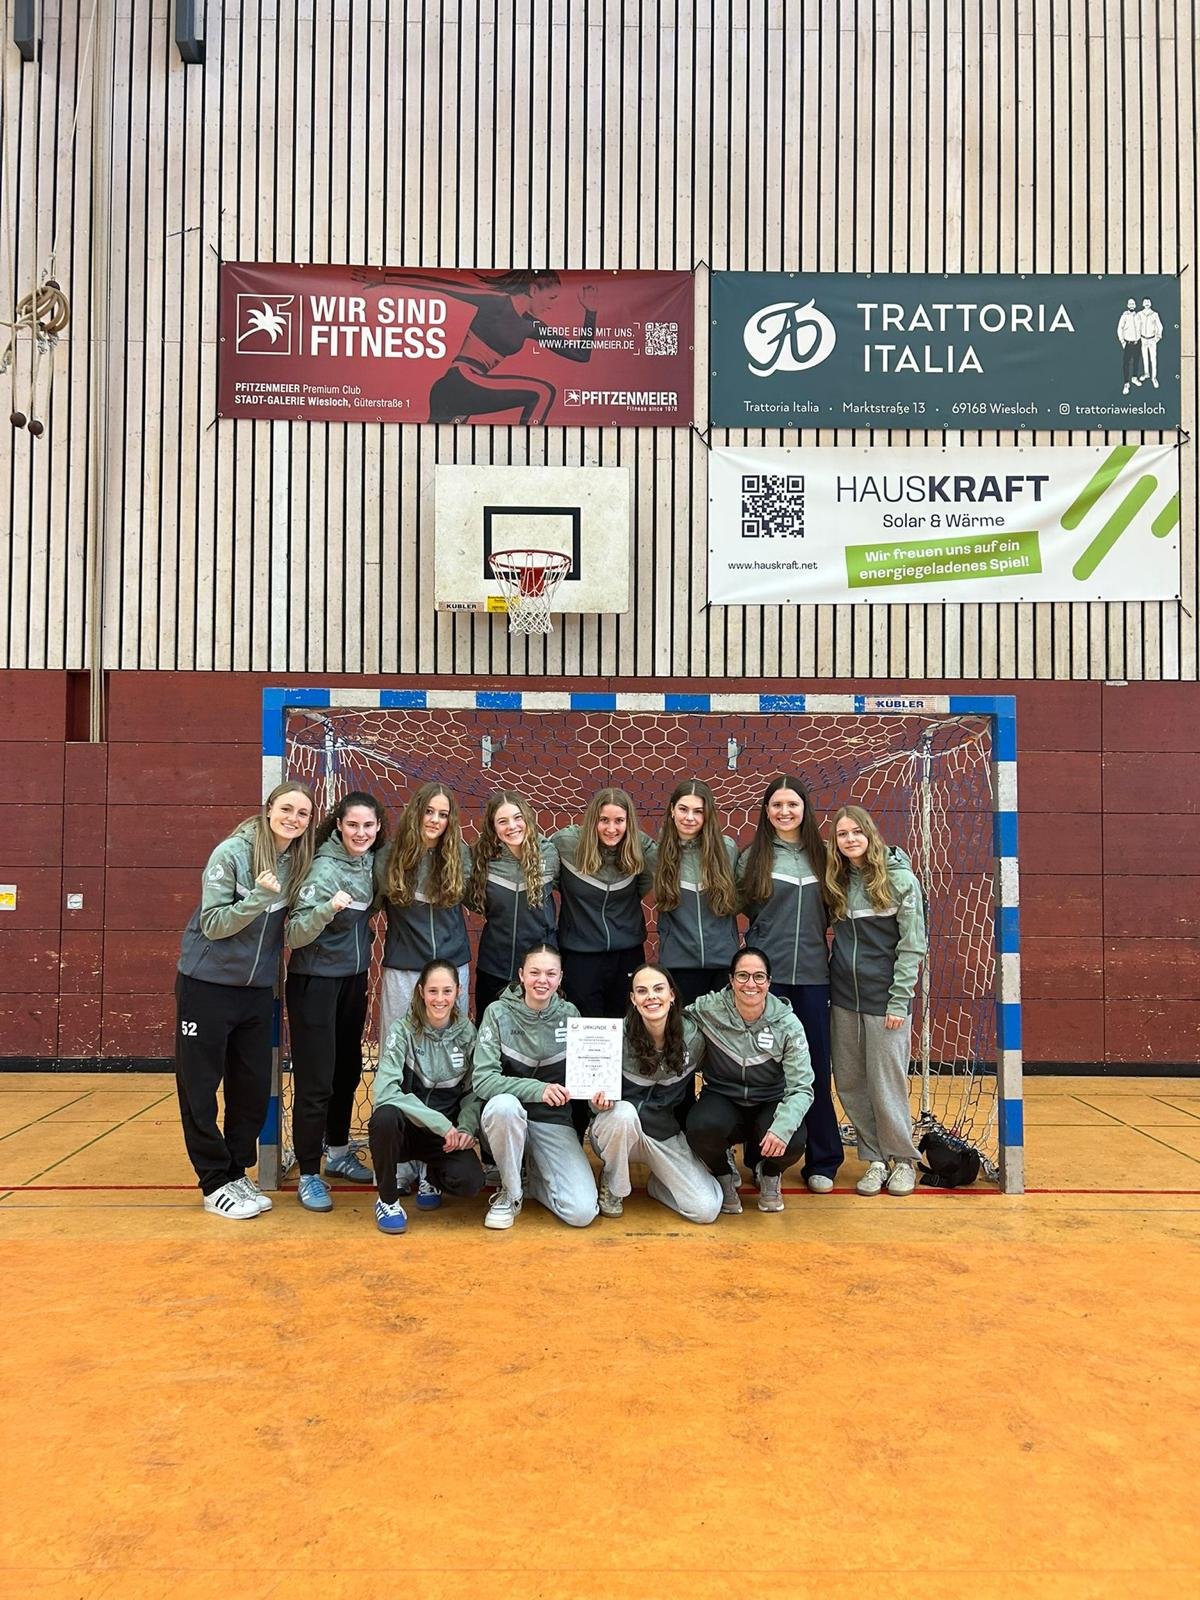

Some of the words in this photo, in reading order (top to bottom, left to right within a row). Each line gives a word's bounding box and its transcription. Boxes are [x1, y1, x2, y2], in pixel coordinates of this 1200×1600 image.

[310, 295, 366, 323] WIR
[377, 297, 447, 325] SIND
[857, 303, 1075, 333] TRATTORIA
[539, 327, 570, 336] WERDE
[573, 327, 593, 337] EINS
[596, 328, 612, 337] MIT
[614, 328, 635, 338] UNS.
[311, 325, 447, 359] FITNESS
[539, 339, 635, 350] WWW.PFITZENMEIER.DE
[864, 345, 984, 374] ITALIA
[235, 382, 300, 393] PFITZENMEIER
[303, 384, 340, 395] Premium
[342, 384, 361, 395] Club
[234, 395, 306, 406] STADT-GALERIE
[308, 396, 351, 408] Wiesloch,
[354, 397, 403, 408] Güterstraße
[406, 398, 411, 408] 1
[582, 391, 678, 406] PFITZENMEIER
[744, 400, 790, 413] Trattoria
[793, 400, 820, 413] Italia
[842, 401, 910, 415] Marktstraße
[913, 402, 926, 414] 13
[951, 402, 987, 415] 69168
[989, 402, 1038, 415] Wiesloch
[1075, 402, 1166, 416] trattoriawiesloch
[836, 475, 1049, 503] HAUSKRAFT
[883, 513, 926, 529] Solar
[930, 514, 941, 528] &
[945, 512, 1005, 528] Wärme
[865, 551, 891, 563] Wir
[893, 547, 943, 560] freuen
[946, 543, 972, 556] uns
[974, 540, 999, 554] auf
[999, 540, 1020, 552] ein
[727, 560, 818, 571] www.hauskraft.net
[859, 560, 987, 582] energiegeladenes
[989, 556, 1030, 573] Spiel!
[876, 699, 924, 708] KÜBLER
[181, 1020, 198, 1036] 52
